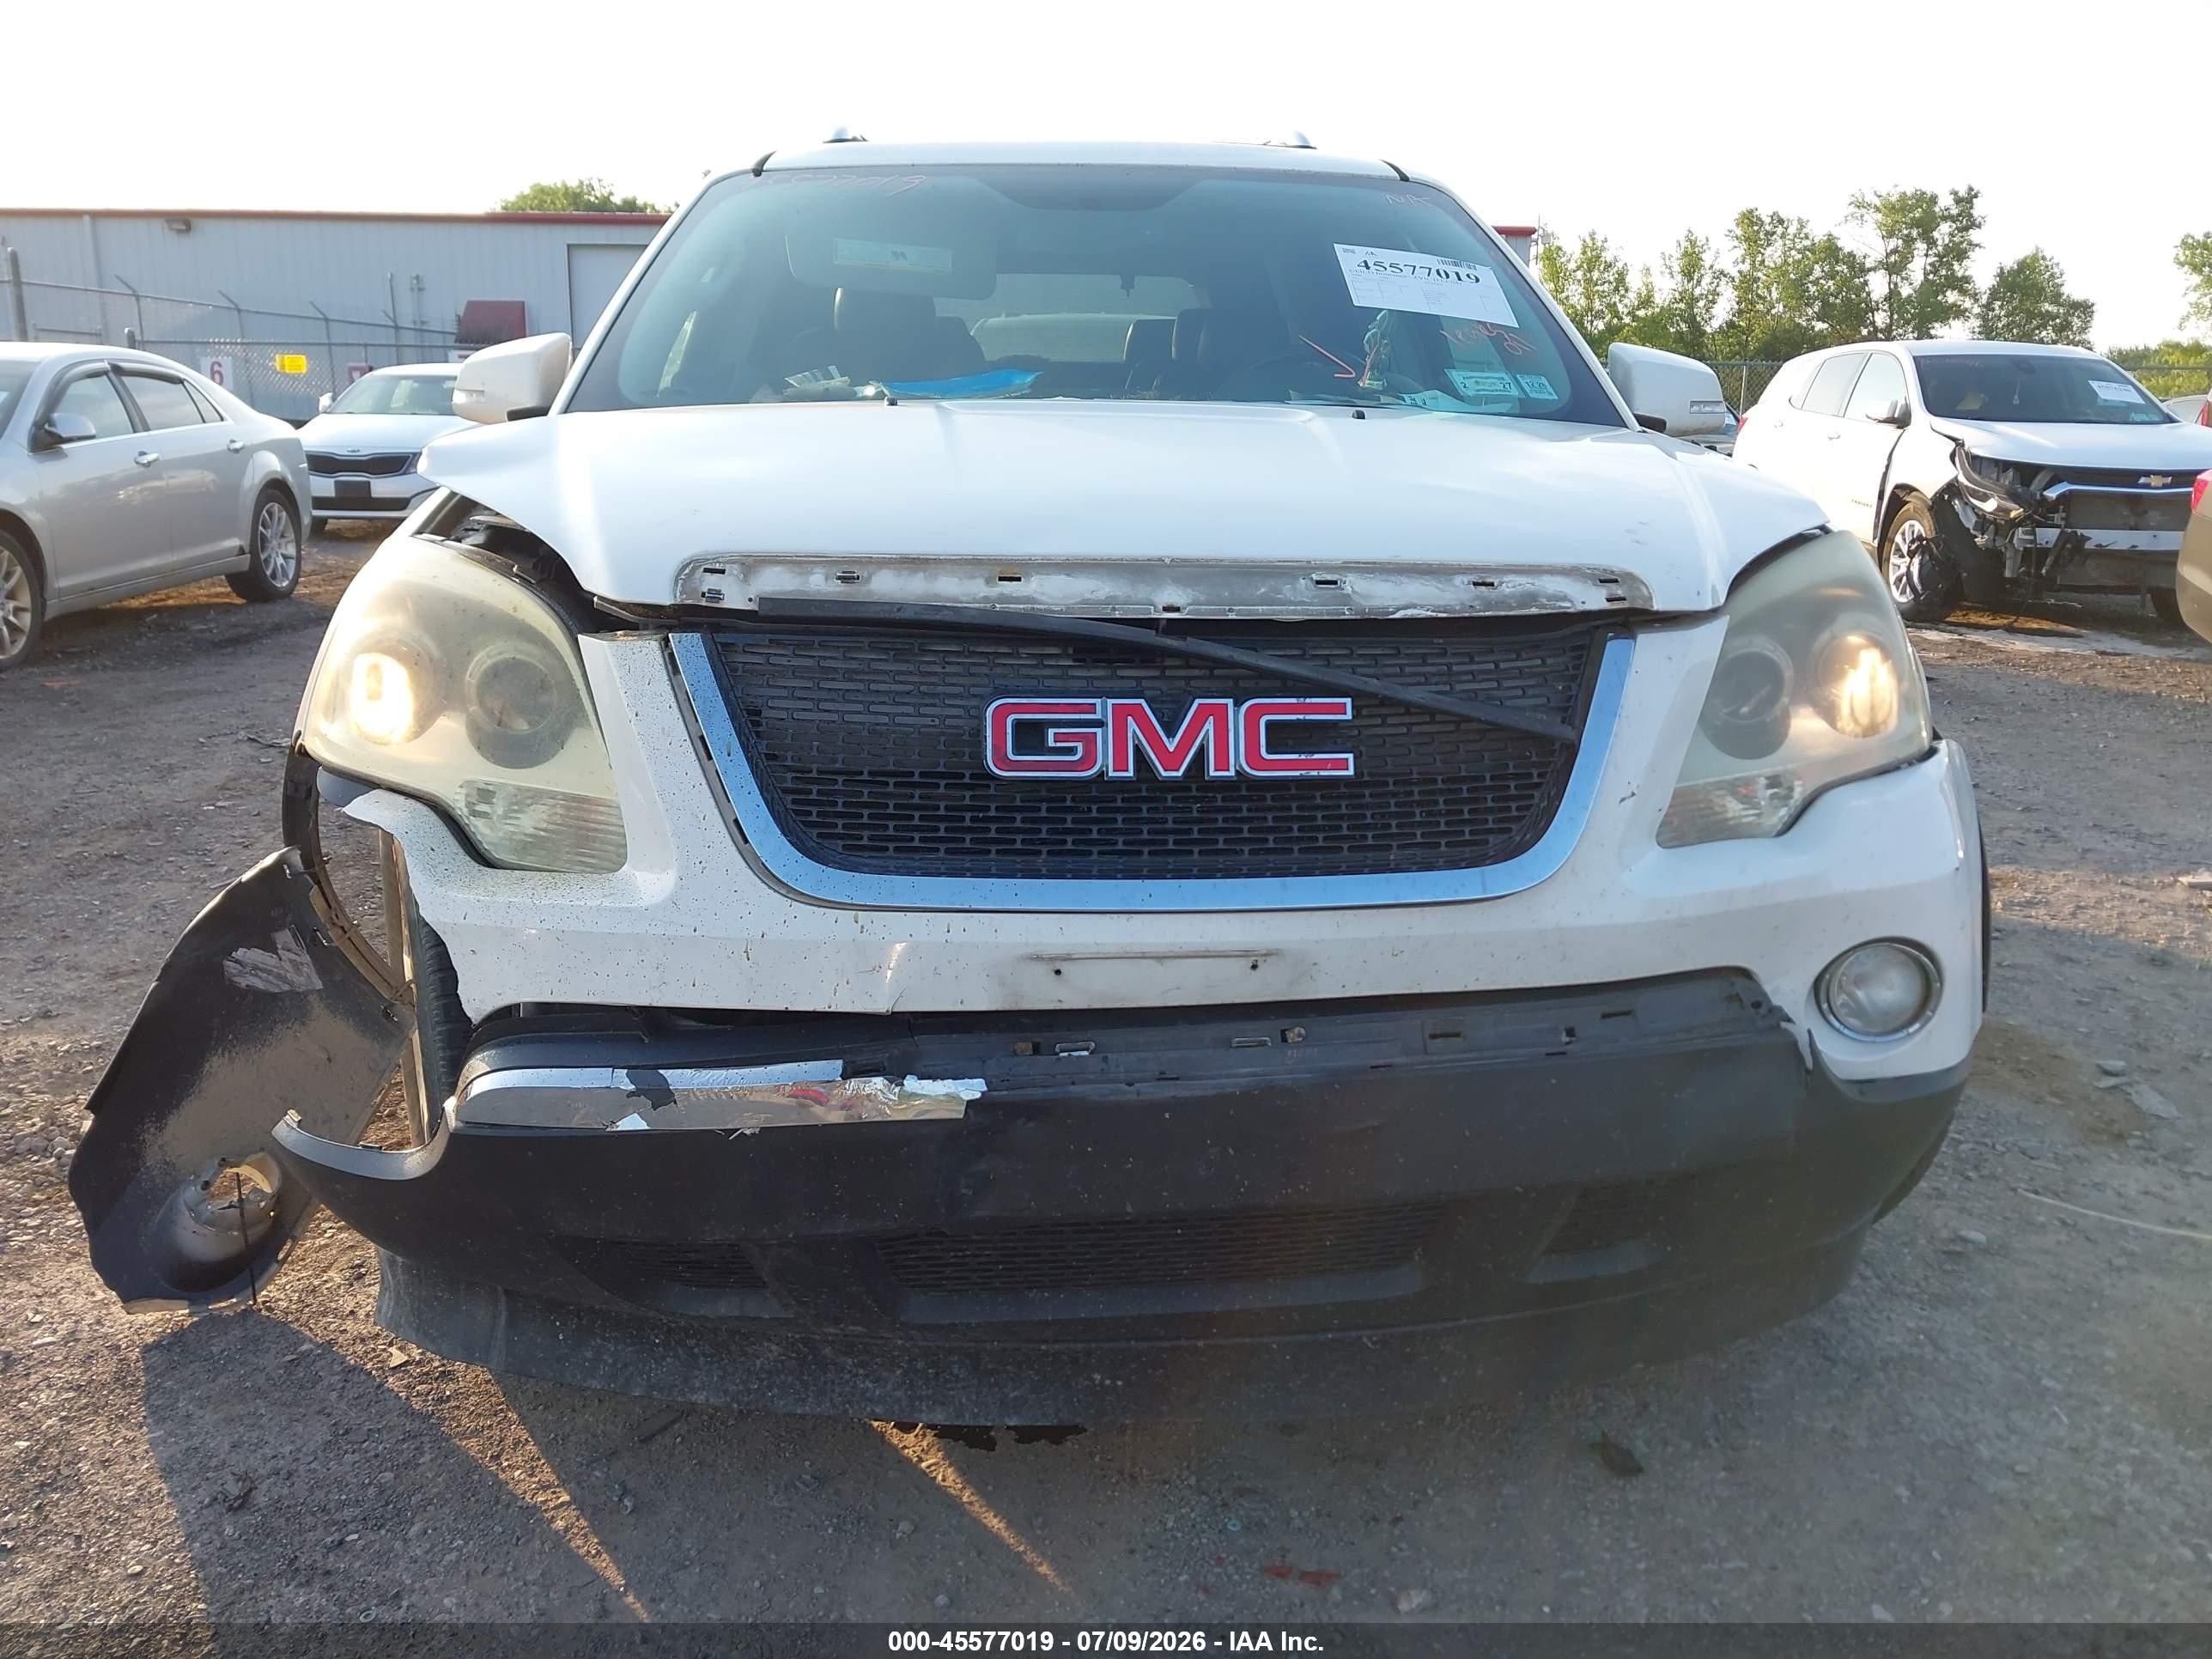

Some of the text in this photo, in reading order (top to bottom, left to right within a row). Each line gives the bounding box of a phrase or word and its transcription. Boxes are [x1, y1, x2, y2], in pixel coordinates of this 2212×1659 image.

[1357, 259, 1480, 283] 45577019
[210, 361, 223, 385] 6
[985, 696, 1355, 778] GMC
